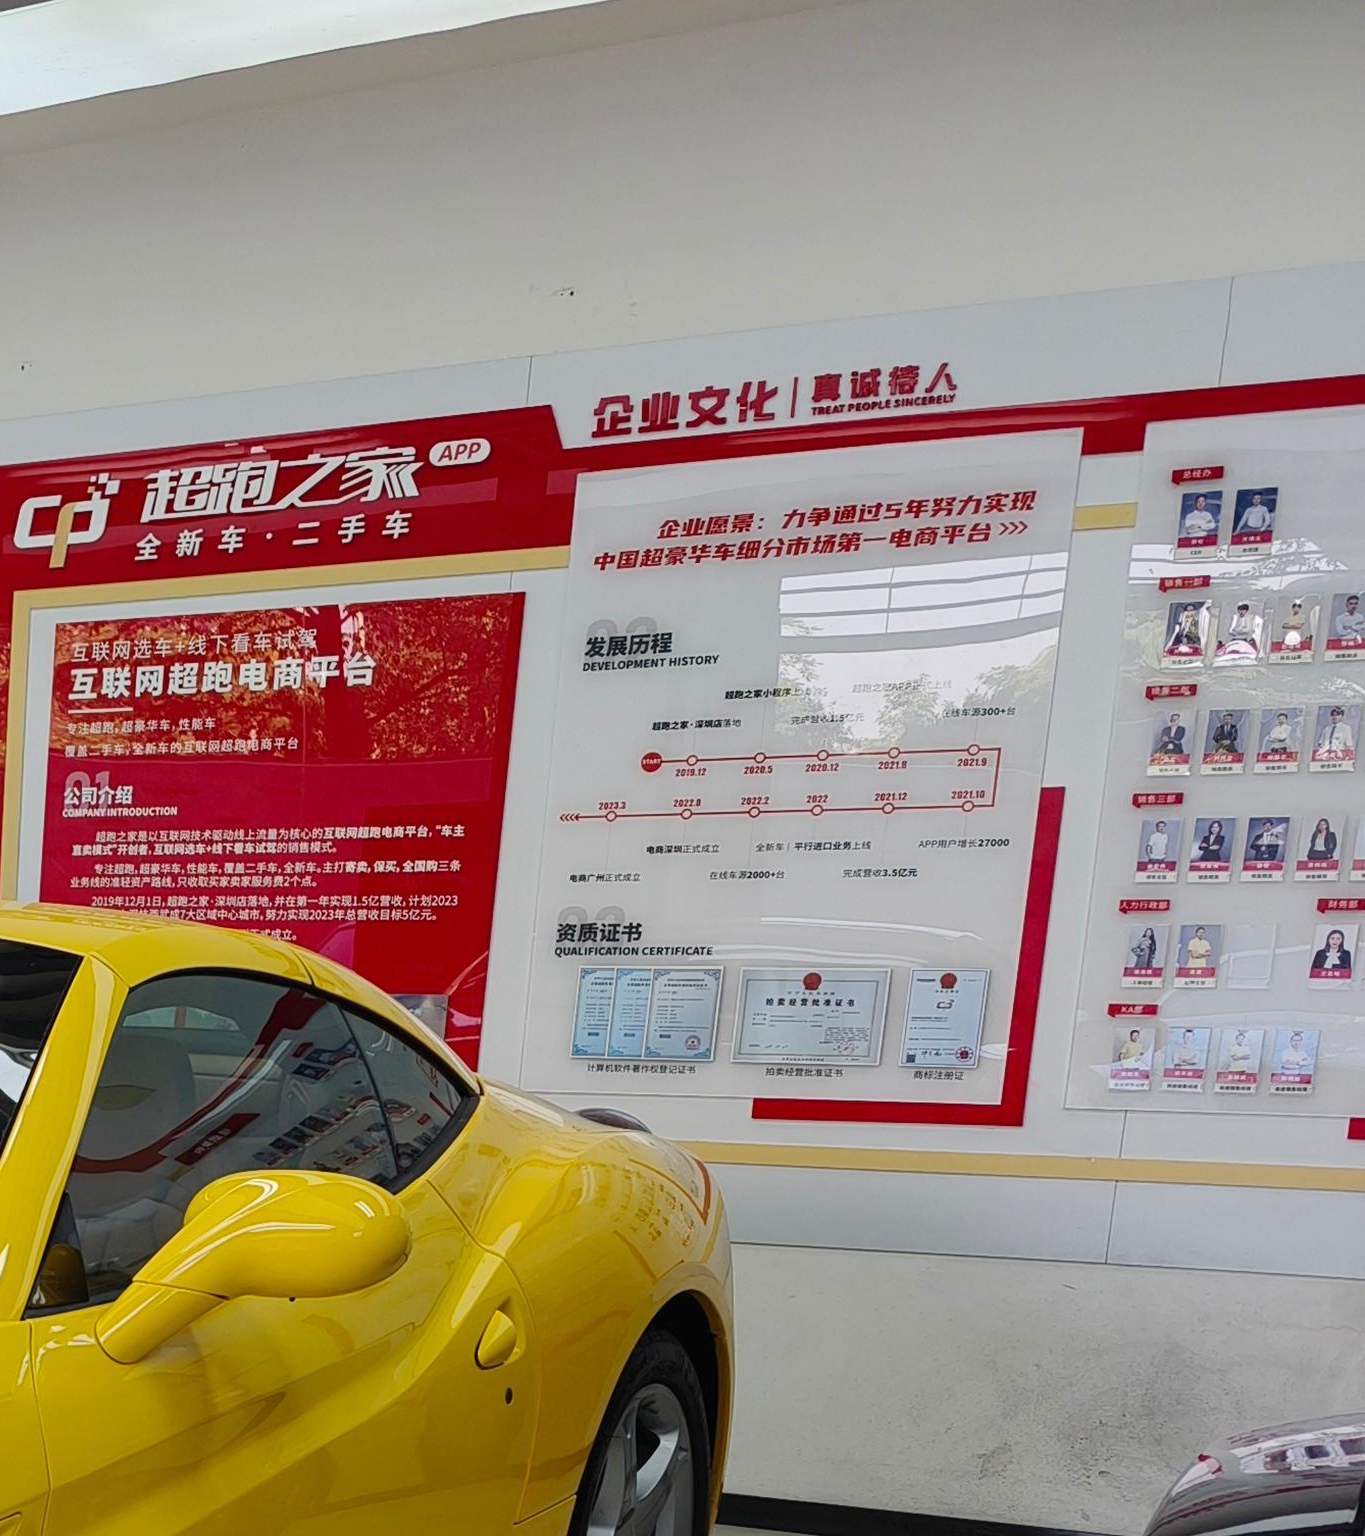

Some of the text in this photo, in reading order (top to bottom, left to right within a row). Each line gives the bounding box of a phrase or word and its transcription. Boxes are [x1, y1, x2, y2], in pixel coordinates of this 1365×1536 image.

[810, 361, 958, 403] 真诚待人
[591, 381, 779, 439] 企业文化
[810, 393, 957, 417] TREAT PEOPLE SINCERELY
[437, 441, 484, 463] APP
[140, 445, 425, 524] 超跑之家
[593, 520, 993, 572] 中国超豪华车细分市场第一电商平台
[69, 628, 318, 664] 互联网选车+线下看车试驾
[584, 631, 673, 658] 发展历程
[582, 654, 721, 672] DEVELOPMENT HISTORY
[67, 651, 377, 701] 互联网超跑电商平台
[675, 767, 707, 777] 2019.12
[743, 765, 774, 775] 2020.5
[805, 763, 840, 773] 2020.12
[957, 757, 988, 768] 2021.9
[63, 785, 134, 806] 公司介绍
[806, 794, 829, 804] 2022
[874, 792, 908, 802] 2021.12
[951, 789, 986, 800] 2021.10
[62, 806, 178, 818] COMPANY INTRODUCTION
[555, 922, 644, 944] 资质证书
[554, 946, 714, 958] QUALIFICATION CERTIFICATE
